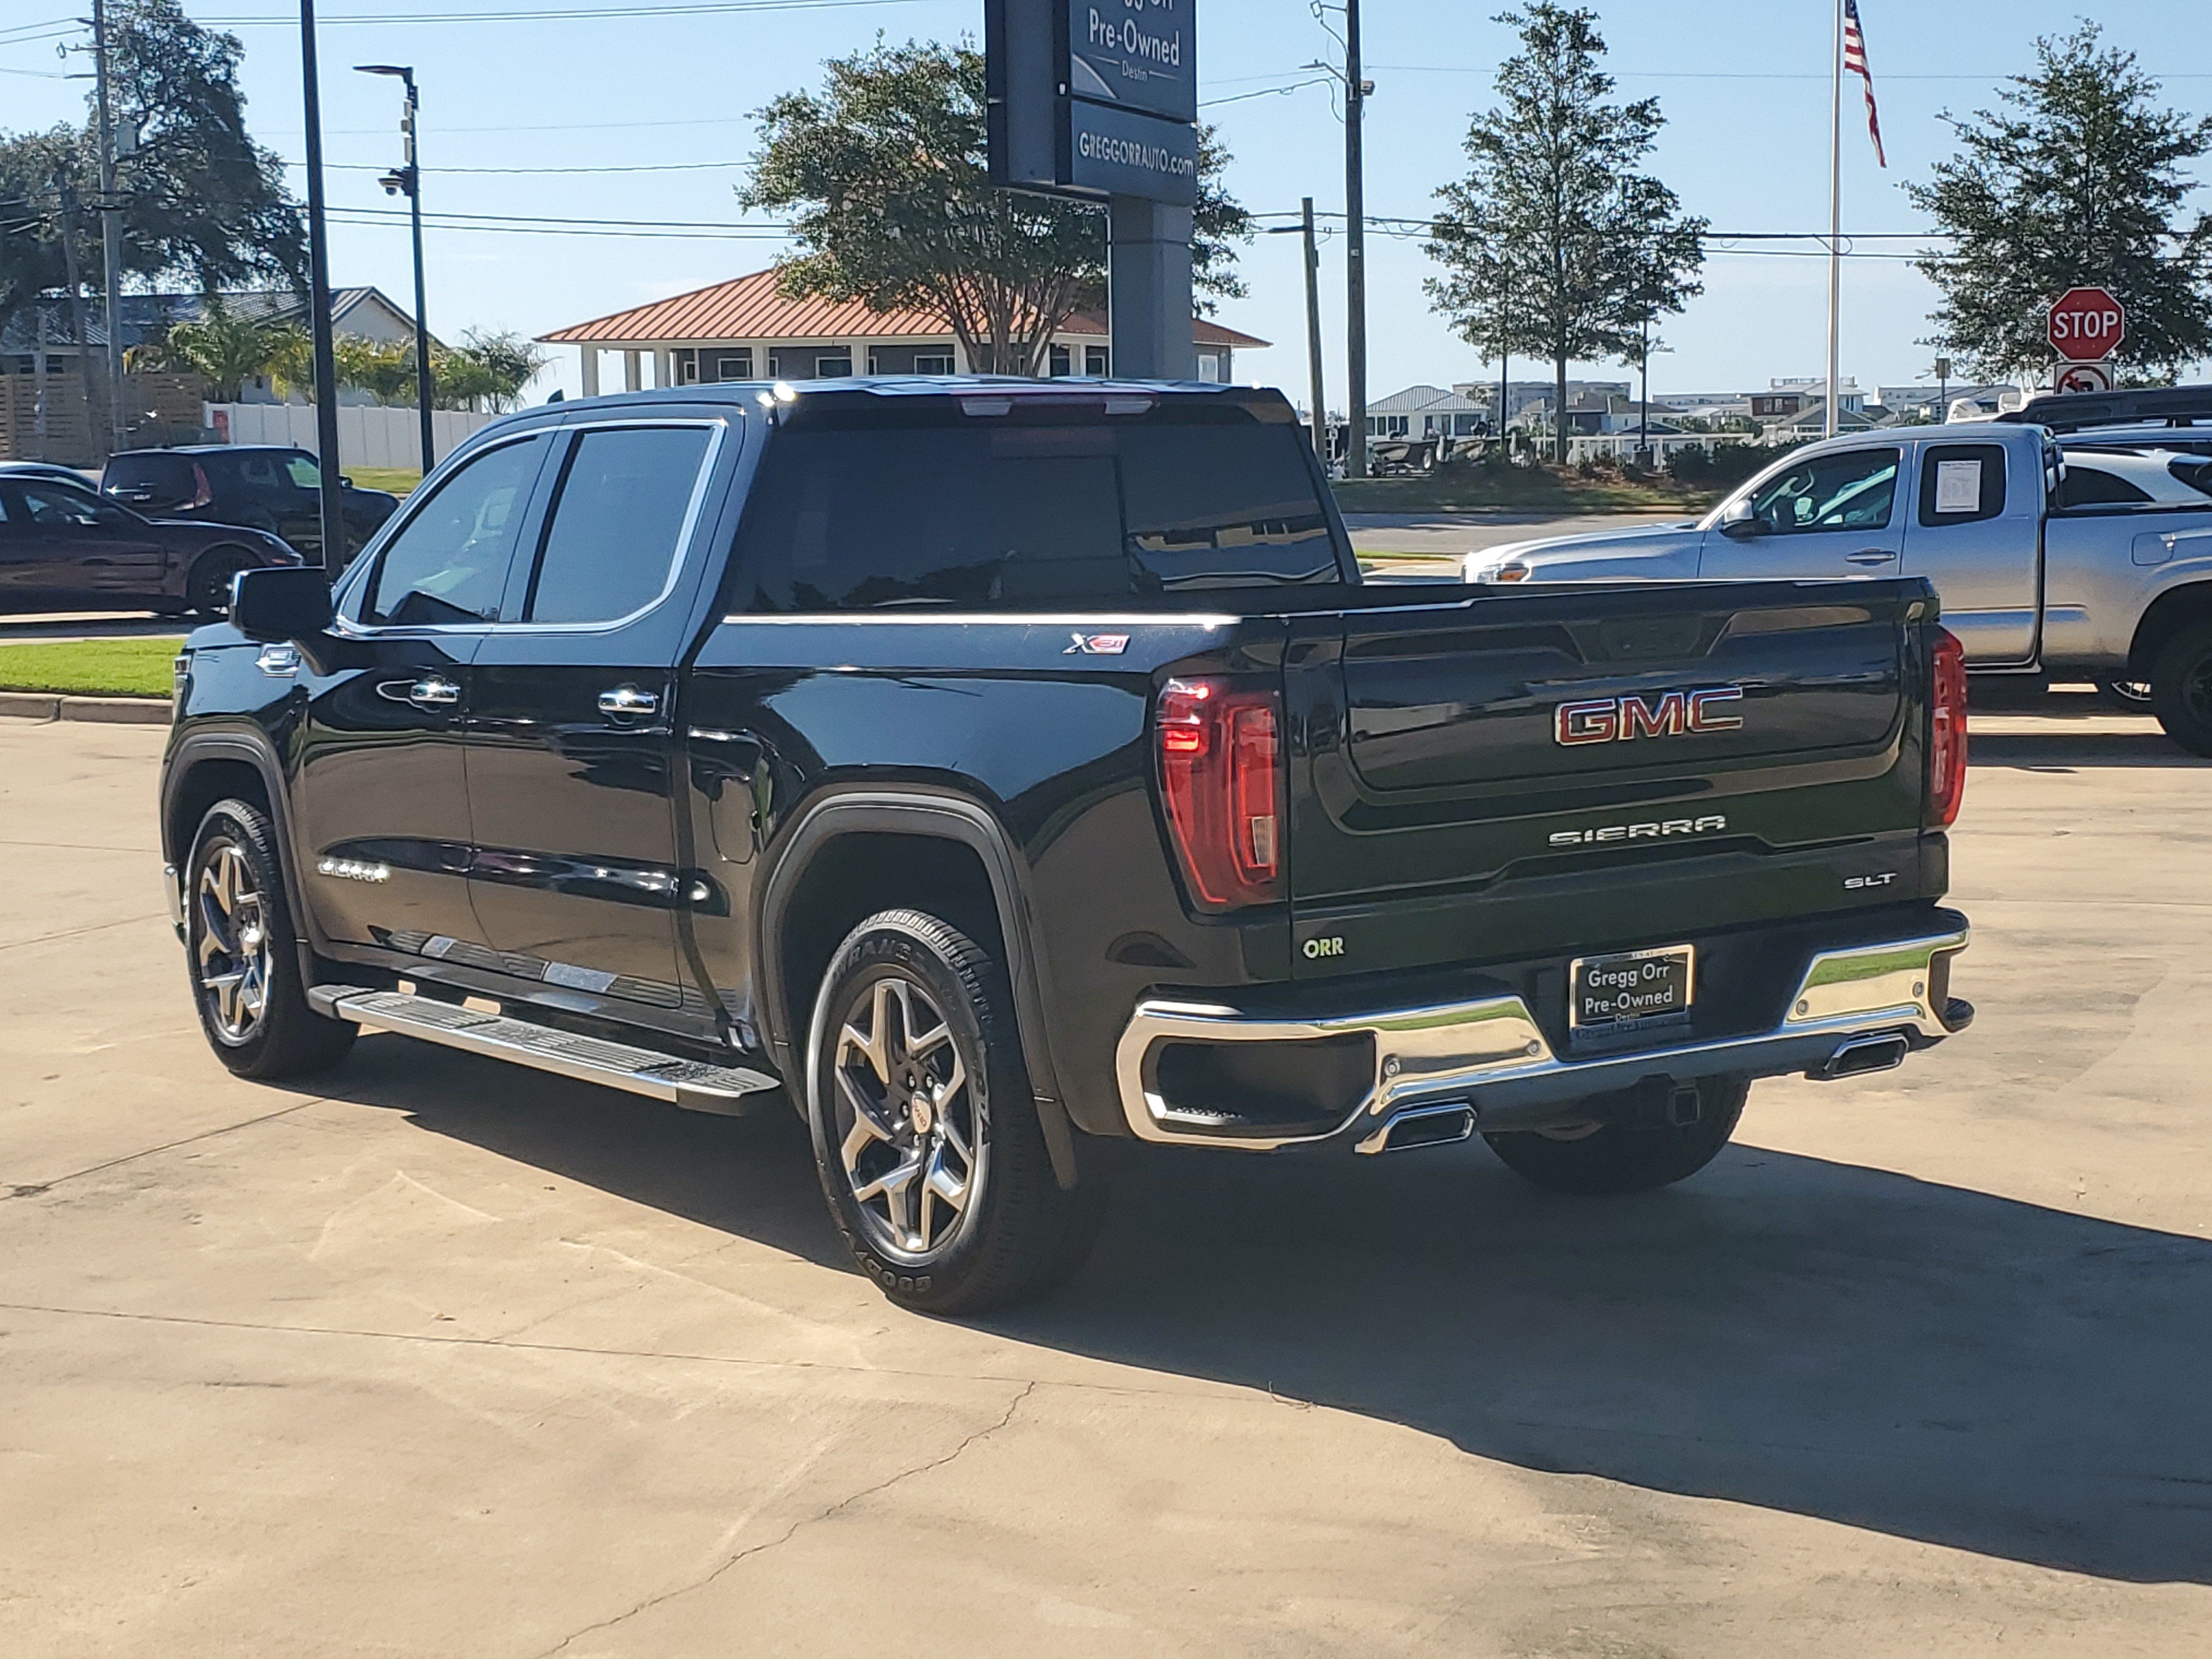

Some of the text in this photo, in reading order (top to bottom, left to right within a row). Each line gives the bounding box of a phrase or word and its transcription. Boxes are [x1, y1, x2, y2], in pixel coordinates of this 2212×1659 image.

[1089, 7, 1180, 66] Pre-Owned
[1079, 131, 1194, 177] GREGGORRAUTO.com
[2053, 311, 2118, 339] STOP
[1555, 686, 1743, 746] GMC
[1548, 815, 1726, 847] SIERRA
[1844, 873, 1897, 888] SLT
[1302, 936, 1344, 958] ORR
[1588, 963, 1670, 988] Gregg Orr
[1585, 985, 1673, 1015] Pre-Owned
